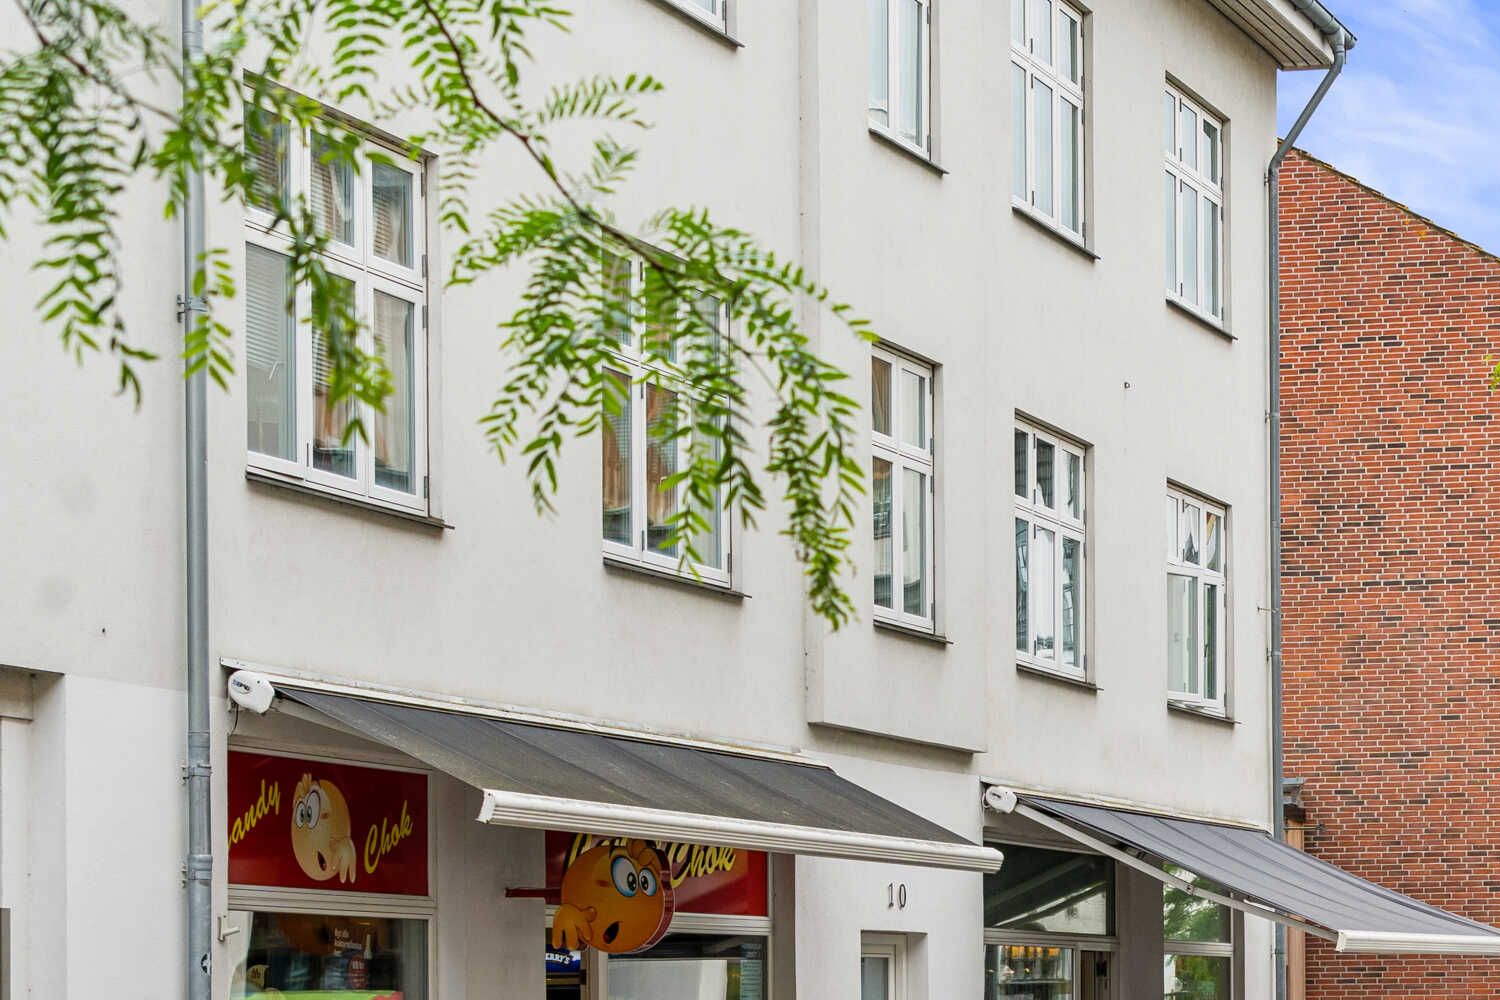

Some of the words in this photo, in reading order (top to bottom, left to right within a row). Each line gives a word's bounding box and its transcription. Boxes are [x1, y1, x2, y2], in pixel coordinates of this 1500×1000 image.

[228, 778, 281, 849] andy
[364, 799, 413, 875] Chok
[888, 883, 907, 909] 10
